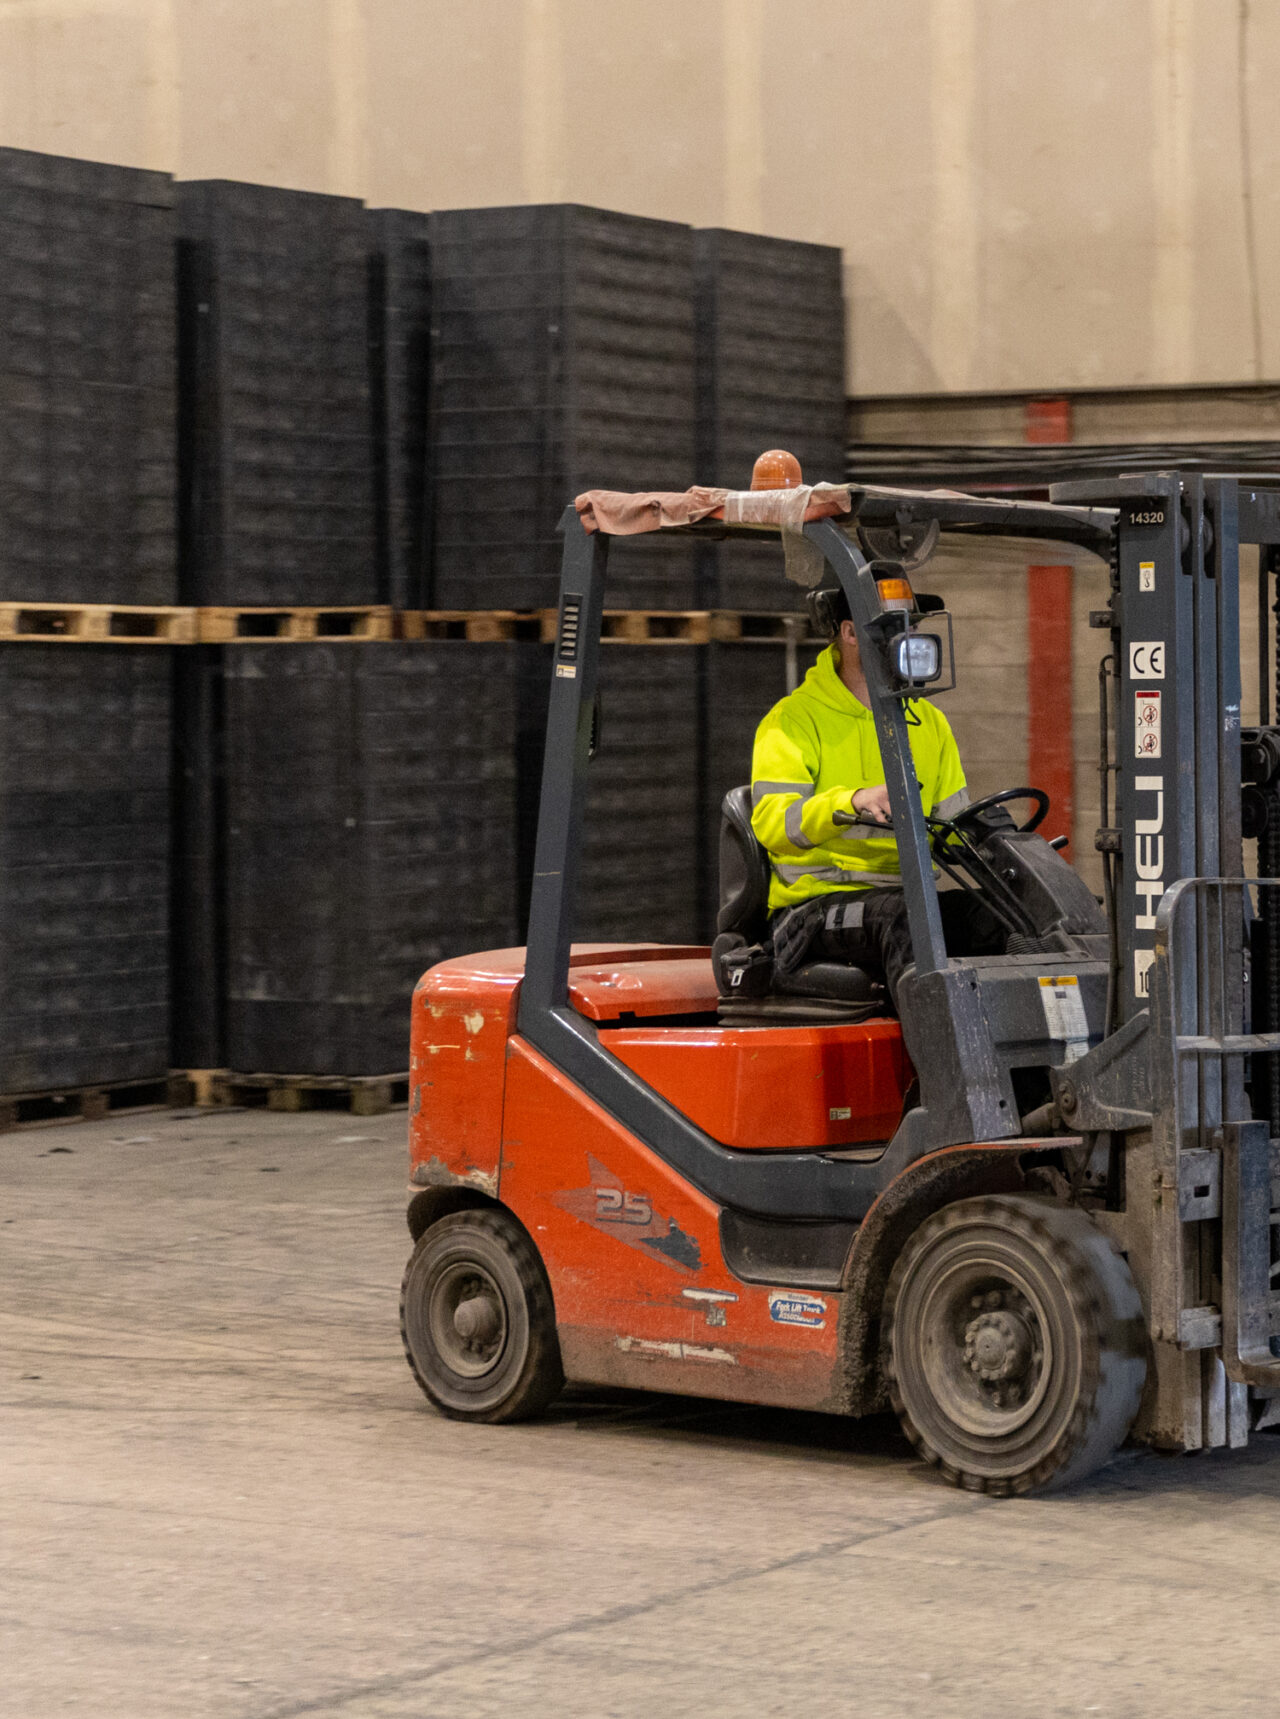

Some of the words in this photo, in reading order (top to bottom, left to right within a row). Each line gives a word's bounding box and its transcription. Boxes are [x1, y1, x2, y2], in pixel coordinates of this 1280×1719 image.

[1129, 512, 1164, 524] 14320
[1133, 646, 1162, 674] CE
[1134, 776, 1164, 930] HELI
[596, 1188, 653, 1226] 25
[776, 1301, 790, 1311] Fork
[791, 1302, 802, 1313] Lift
